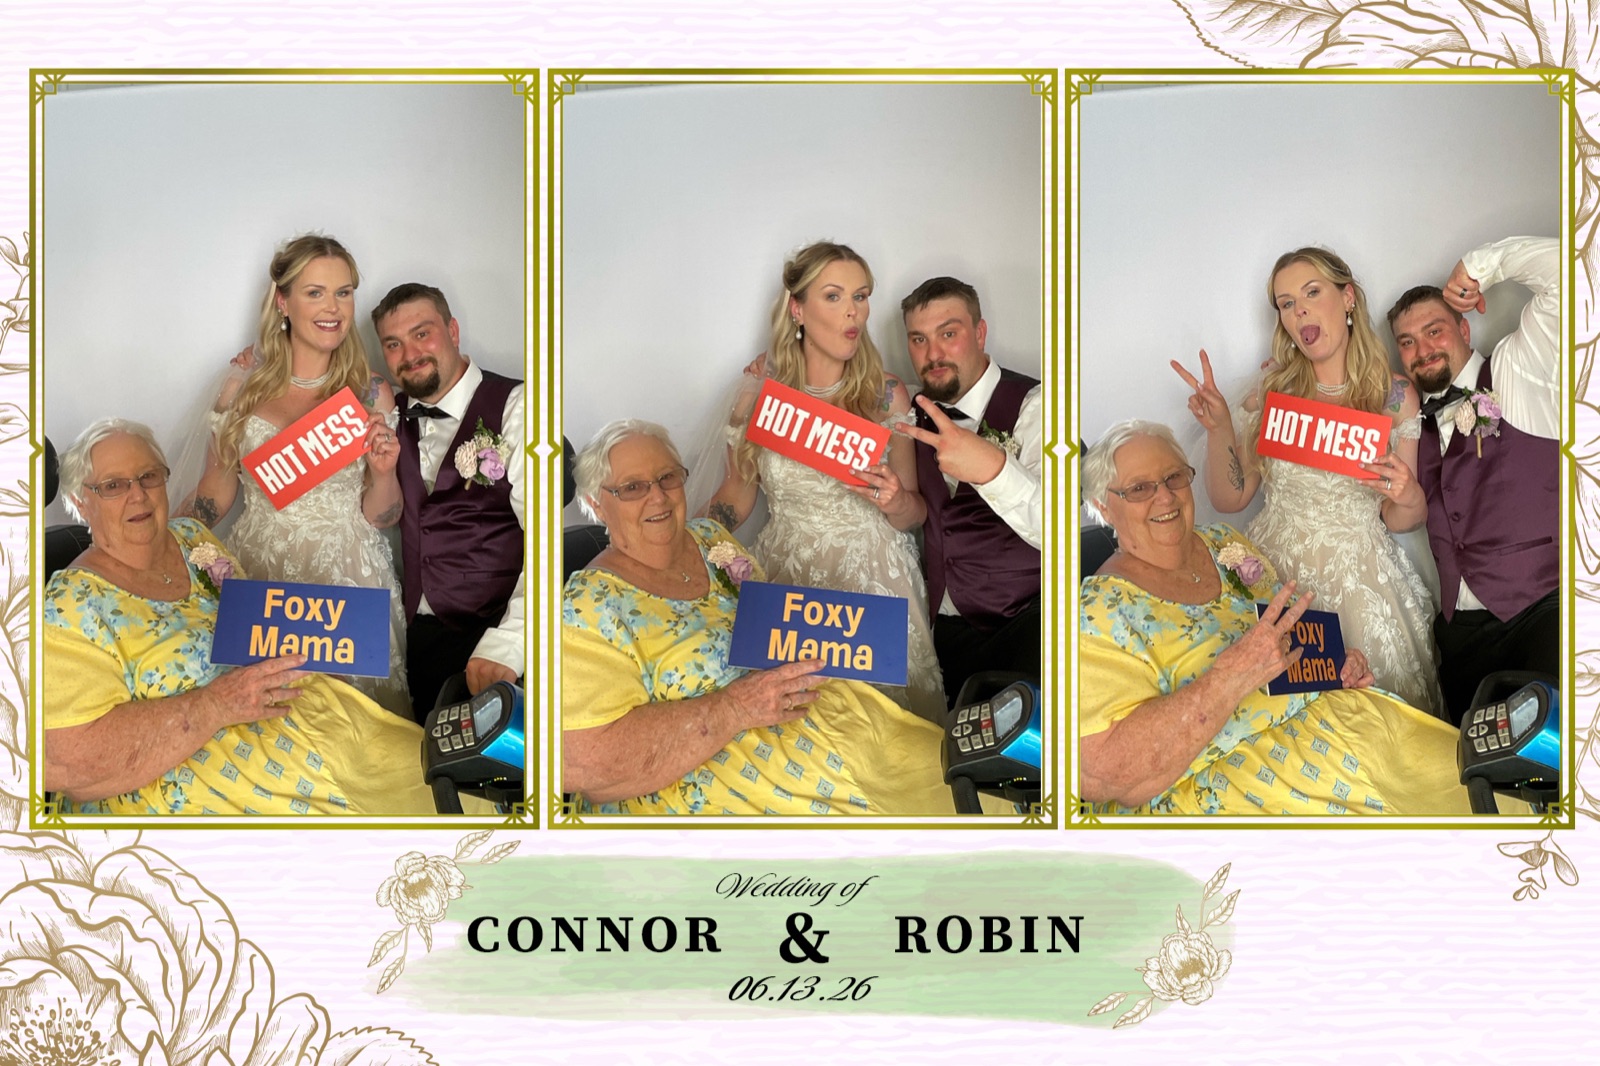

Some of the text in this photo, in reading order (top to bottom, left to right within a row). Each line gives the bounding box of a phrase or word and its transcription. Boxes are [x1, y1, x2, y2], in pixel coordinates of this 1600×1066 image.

[255, 404, 367, 495] HOT MESS
[756, 394, 877, 472] HOT MESS
[1264, 407, 1381, 464] HOT MESS
[264, 588, 346, 631] Foxy
[783, 592, 865, 638] Foxy
[249, 625, 355, 664] Mama
[767, 628, 873, 671] Mama
